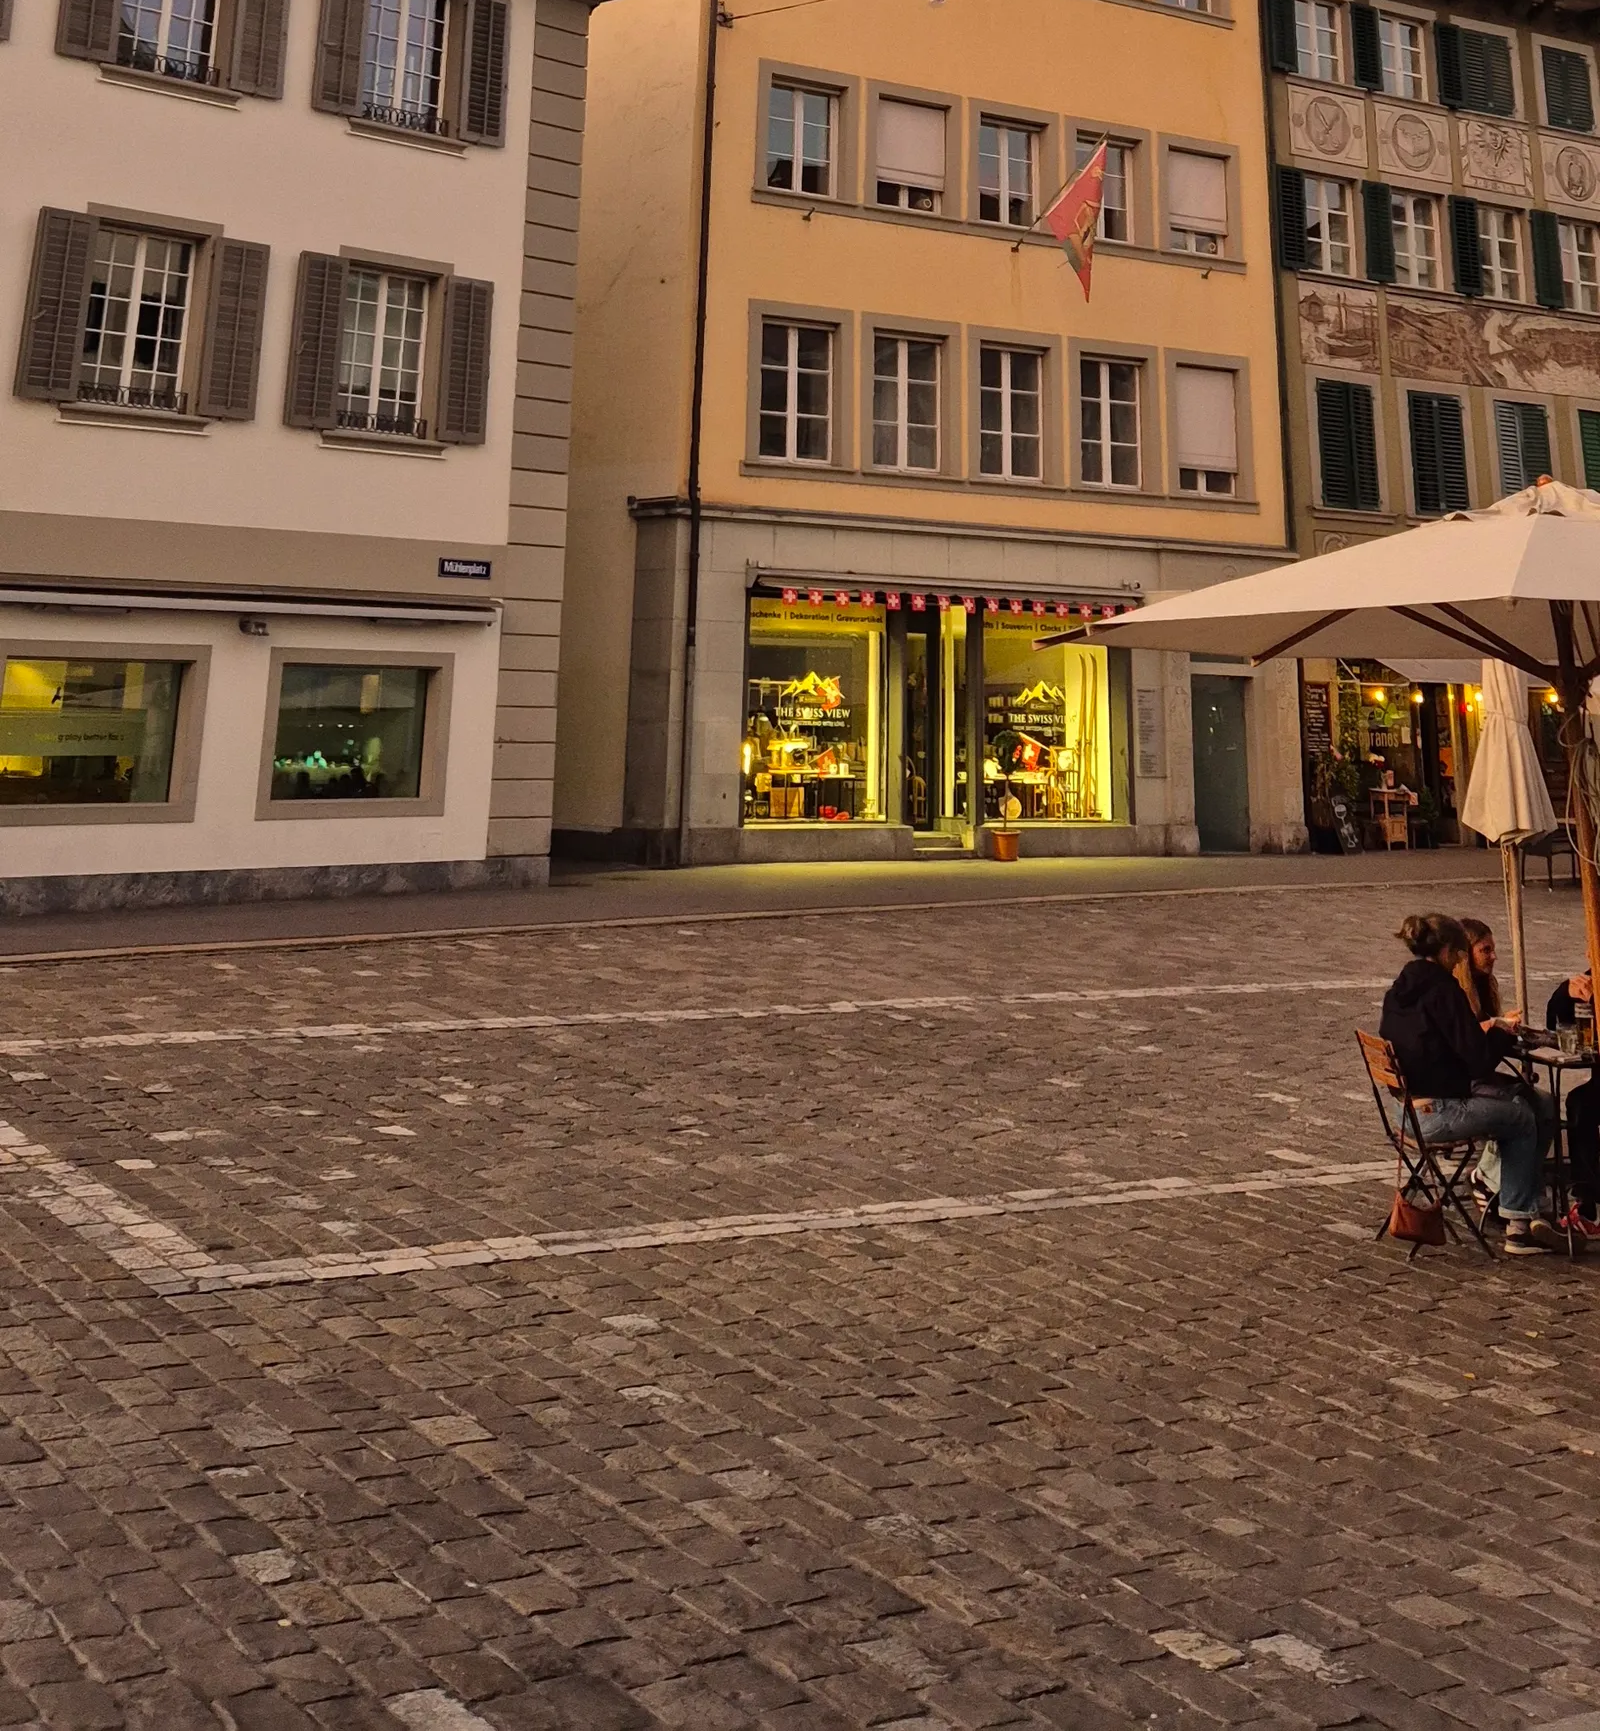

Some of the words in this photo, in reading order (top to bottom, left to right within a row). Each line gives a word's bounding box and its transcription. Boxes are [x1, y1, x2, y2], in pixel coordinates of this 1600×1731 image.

[443, 561, 487, 575] Mühlenplatz
[790, 611, 829, 621] Dekoration
[1001, 621, 1033, 631] Souvenirs
[773, 707, 794, 718] THE
[825, 708, 850, 719] VIEW
[1009, 713, 1027, 724] THE
[1028, 713, 1053, 724] SWISS
